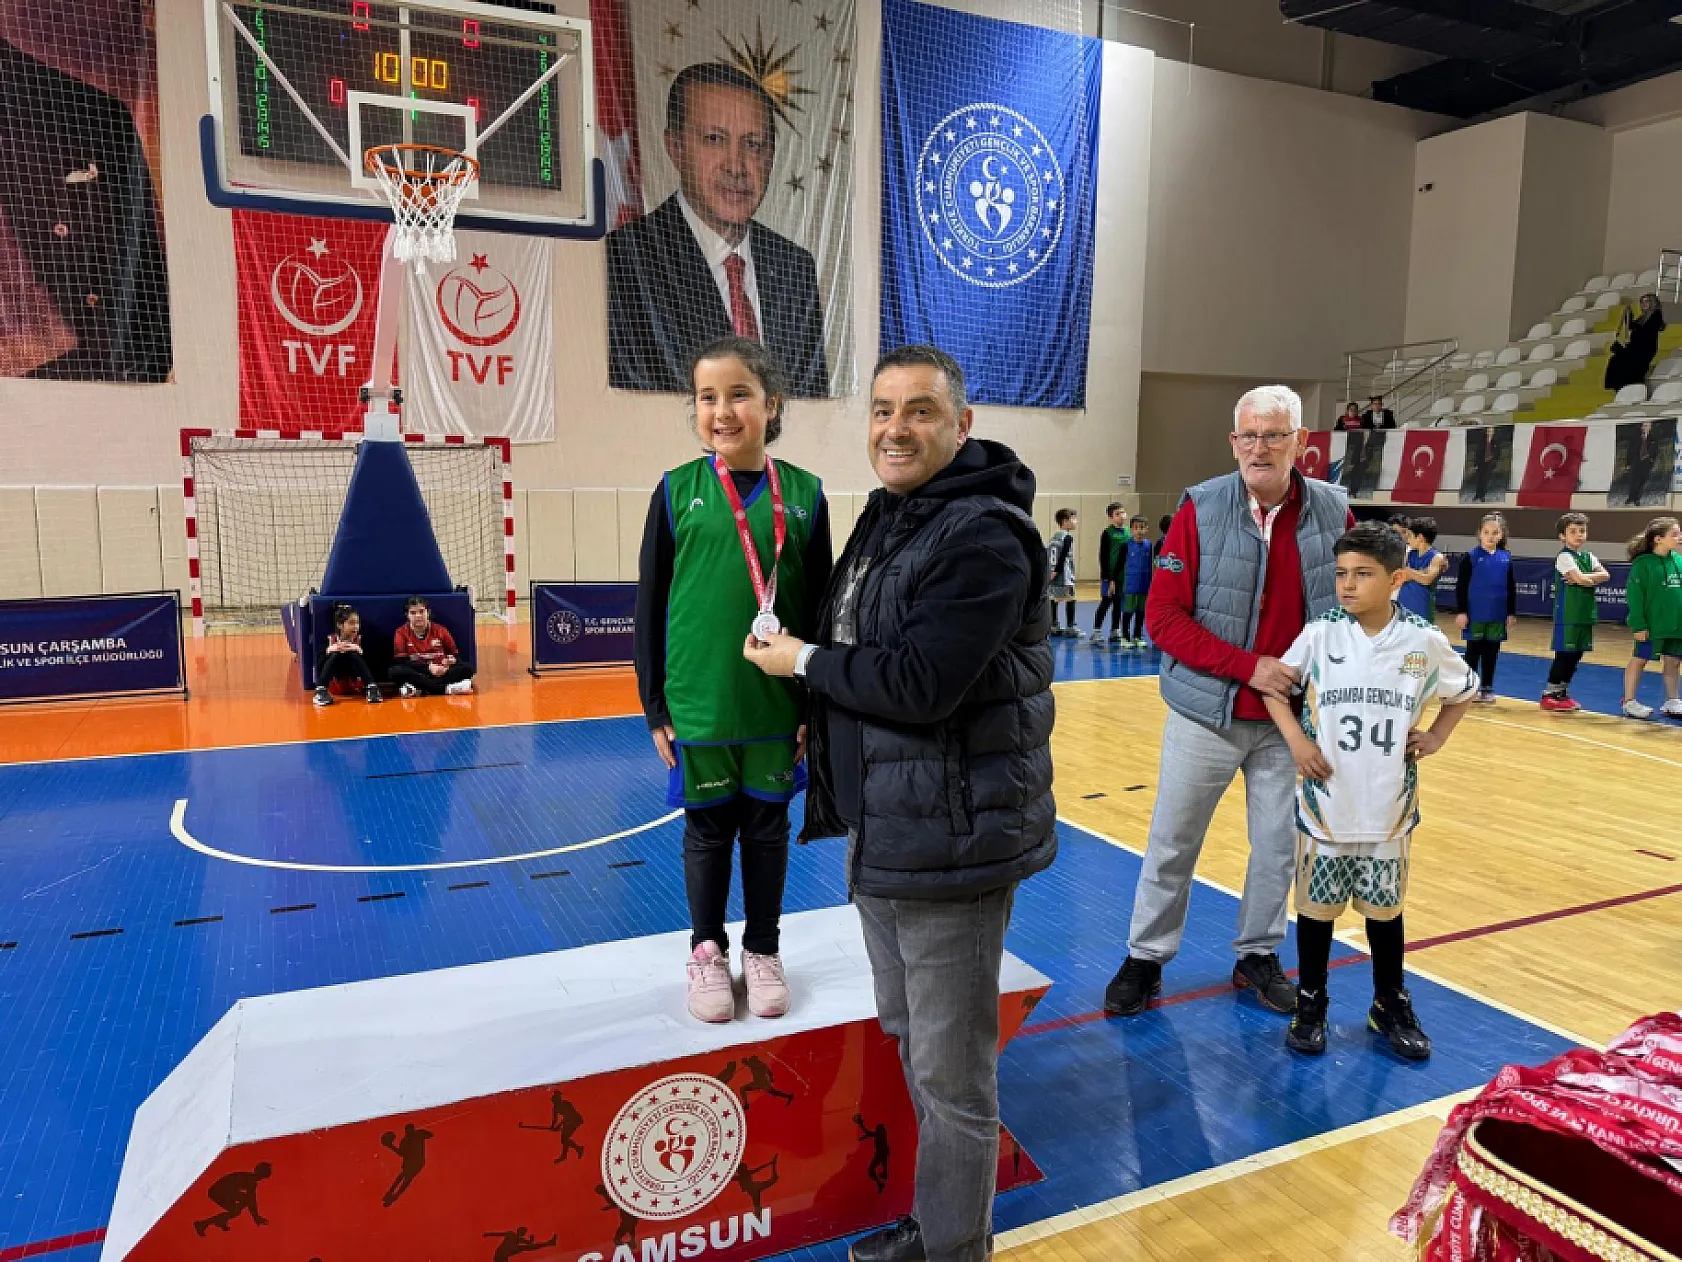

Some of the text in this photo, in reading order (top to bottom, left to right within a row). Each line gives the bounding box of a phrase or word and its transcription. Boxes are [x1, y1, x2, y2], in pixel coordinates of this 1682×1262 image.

[375, 52, 448, 90] 10 00
[282, 340, 356, 376] TVF
[447, 350, 514, 385] TVF
[18, 656, 33, 667] VE
[34, 655, 65, 667] SPOR
[91, 649, 164, 663] MÜDÜRLÜĞÜ
[38, 637, 128, 656] ÇARŞAMBA
[1337, 714, 1397, 757] 34
